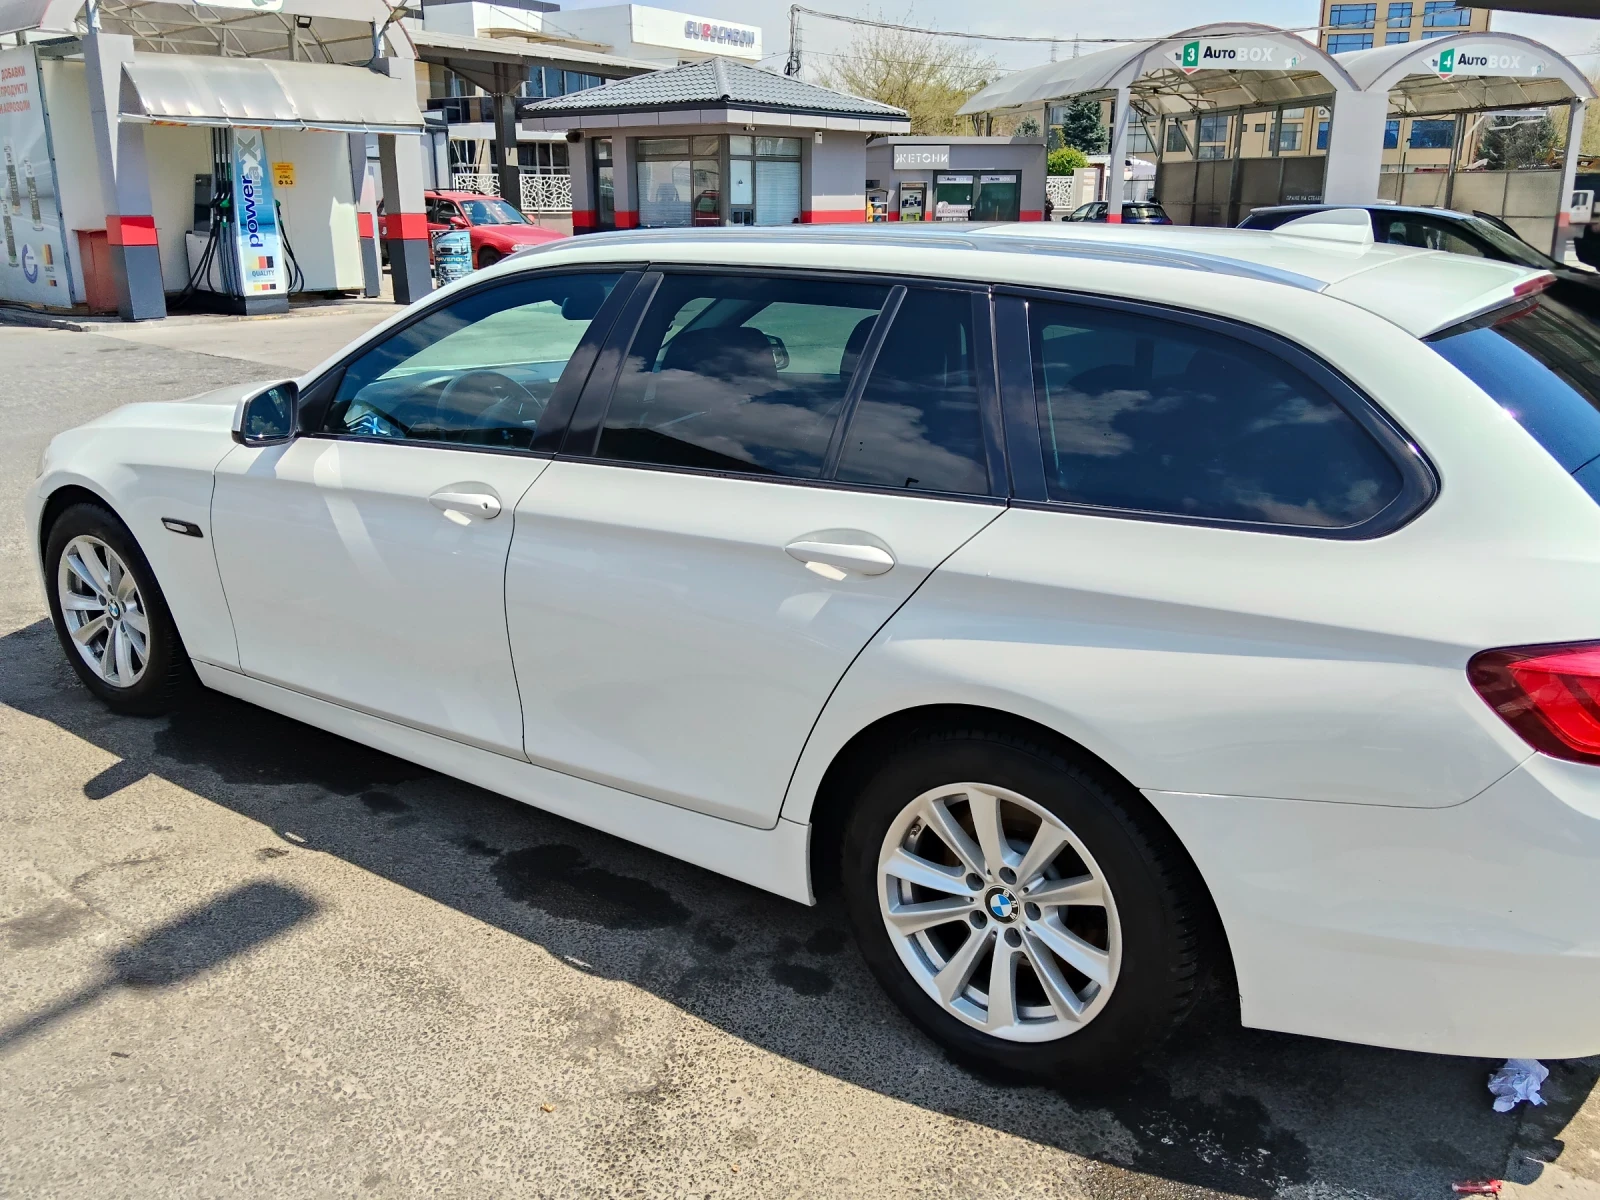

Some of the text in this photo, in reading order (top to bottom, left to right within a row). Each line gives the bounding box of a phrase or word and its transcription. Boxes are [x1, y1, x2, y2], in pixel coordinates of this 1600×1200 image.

[1187, 47, 1195, 62] 3
[1443, 55, 1451, 68] 4
[1, 65, 26, 81] ДОБАВКИ
[895, 153, 948, 163] ЖЕТОНИ
[241, 173, 263, 248] power
[251, 269, 275, 277] QUALITY
